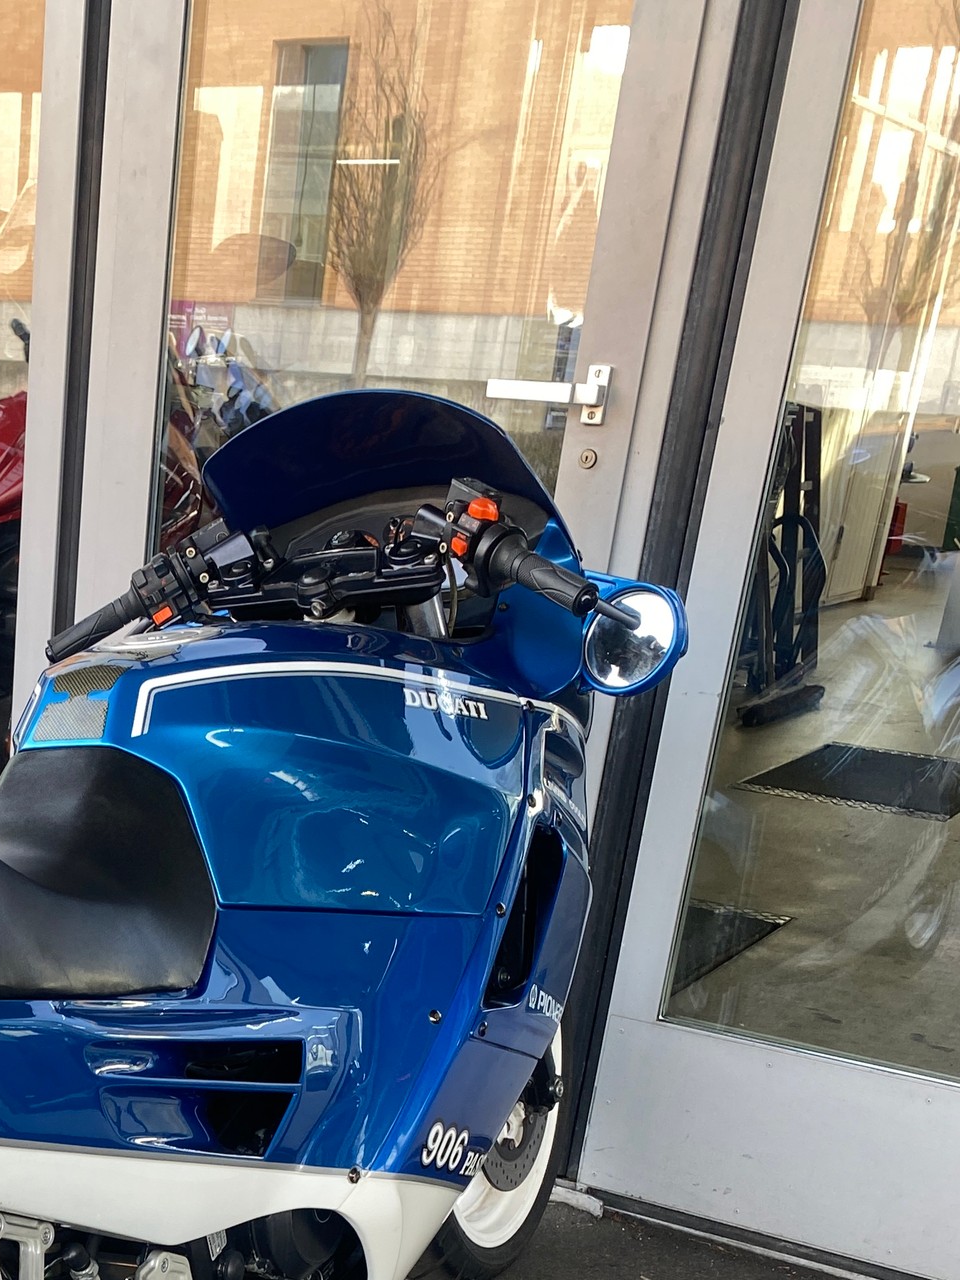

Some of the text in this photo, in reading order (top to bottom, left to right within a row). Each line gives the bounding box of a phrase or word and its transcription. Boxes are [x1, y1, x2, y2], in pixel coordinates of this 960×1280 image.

[403, 687, 489, 720] DUCATI
[421, 1122, 487, 1177] 906 PAS
